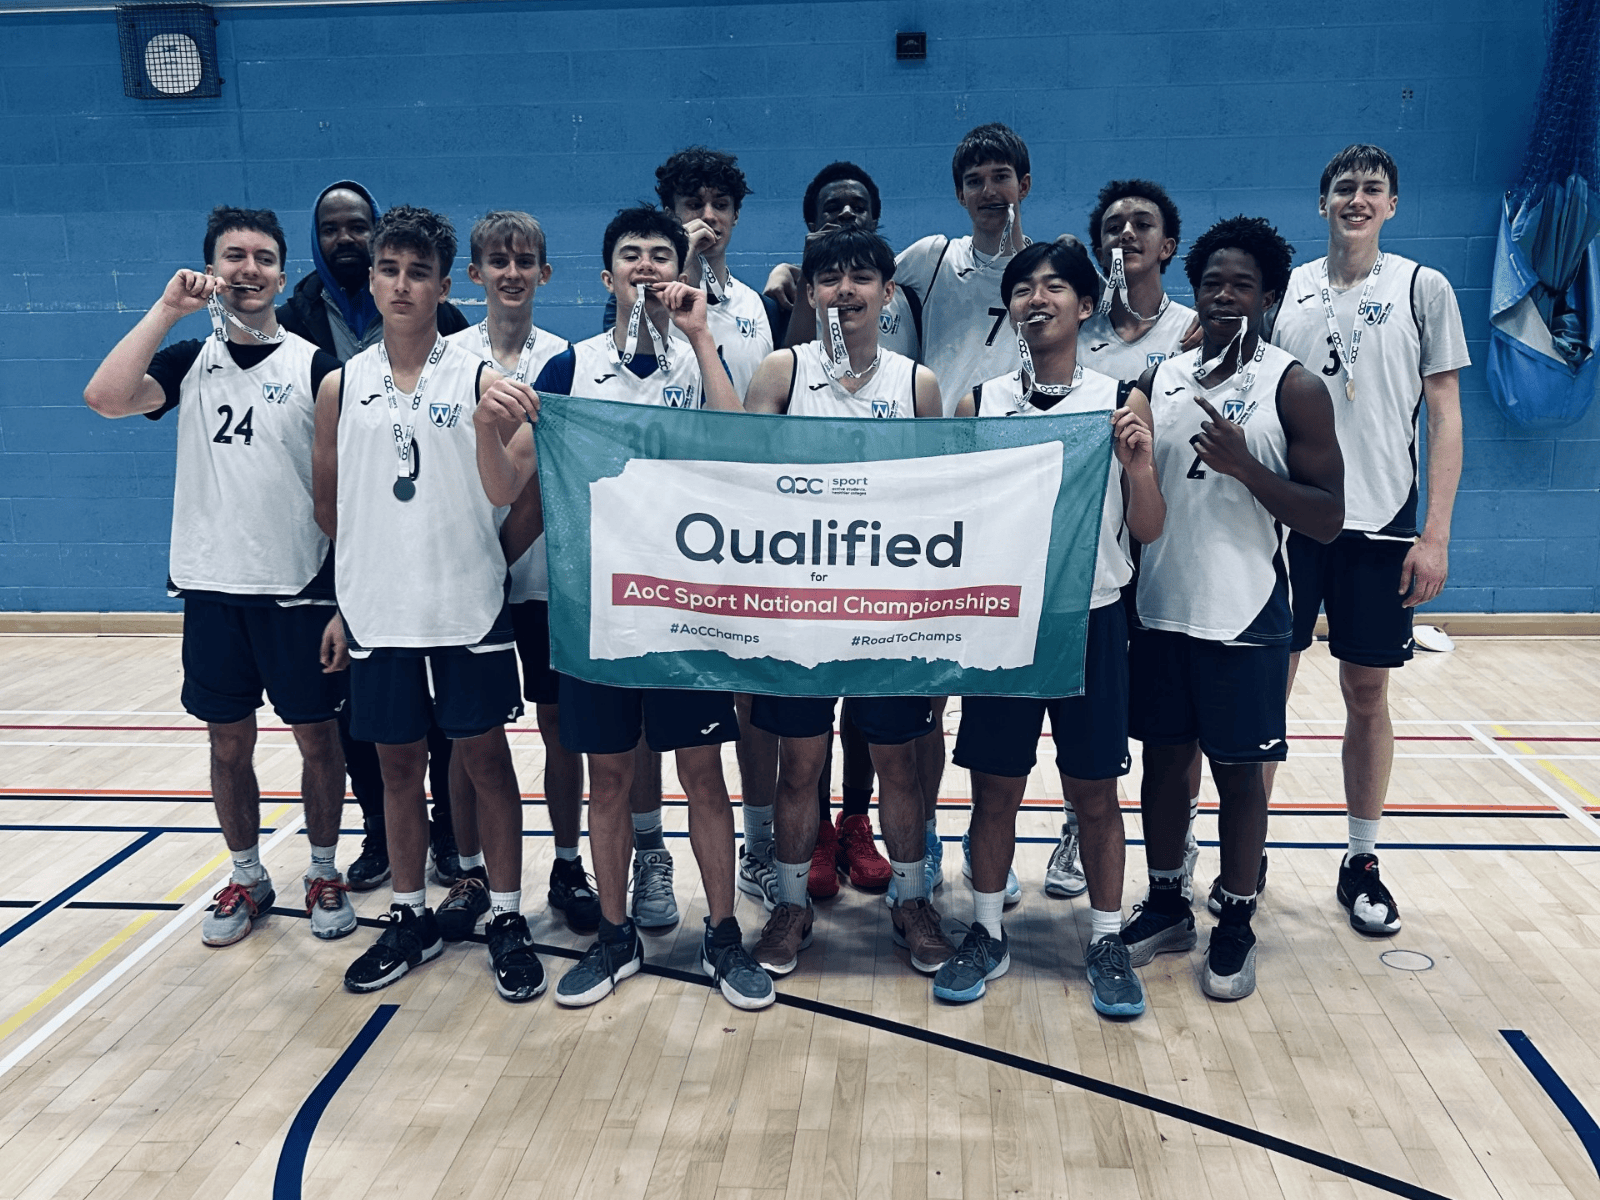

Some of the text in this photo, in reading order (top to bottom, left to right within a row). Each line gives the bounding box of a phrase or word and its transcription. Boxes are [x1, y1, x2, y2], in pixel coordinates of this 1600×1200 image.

[985, 307, 1008, 346] 7
[1321, 335, 1341, 377] 3
[212, 404, 254, 446] 24
[777, 475, 868, 494] aoc sport
[675, 512, 964, 569] Qualified
[810, 572, 828, 582] for
[623, 581, 1011, 618] AoC Sport National Championships
[670, 622, 760, 644] #AoCChamps
[851, 631, 962, 646] #RoadToChamps
